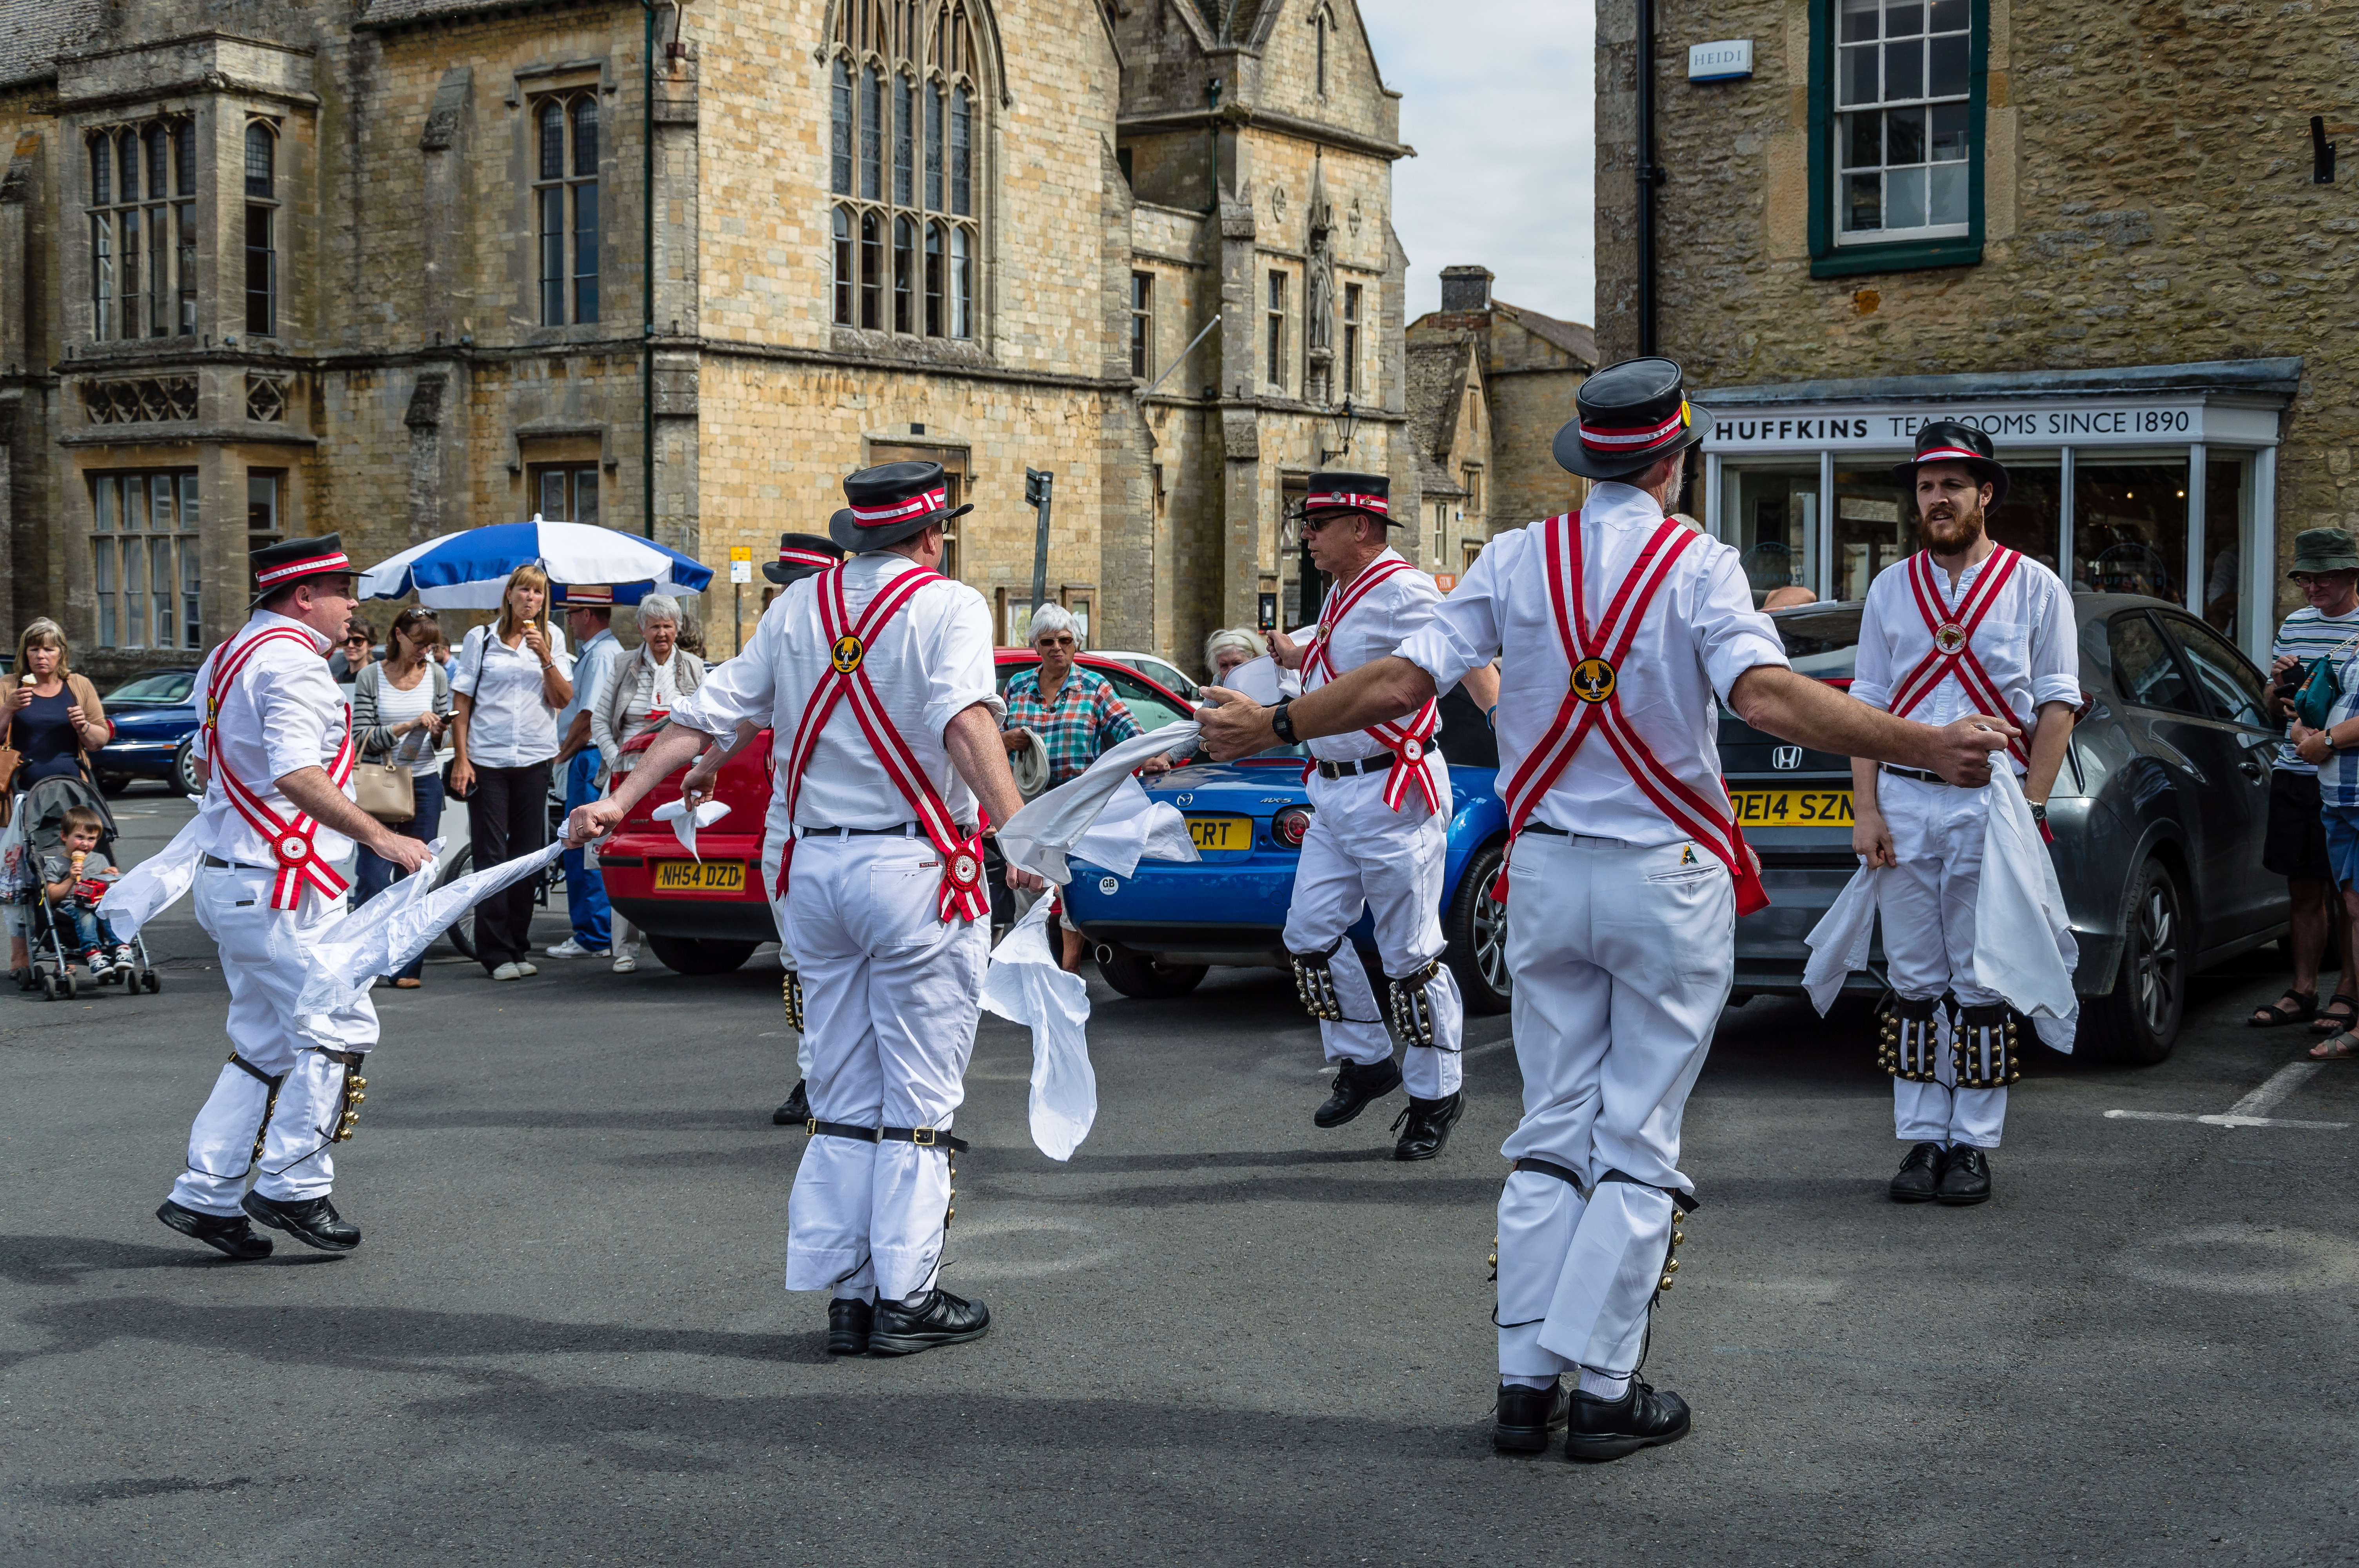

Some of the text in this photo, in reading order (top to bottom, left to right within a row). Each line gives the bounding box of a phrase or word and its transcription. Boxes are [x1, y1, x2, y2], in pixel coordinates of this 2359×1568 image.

[1694, 50, 1741, 66] HEIDI
[1716, 419, 1868, 440] HUFFKINS
[2048, 412, 2126, 434] SINCE
[2136, 411, 2189, 432] 1890
[1439, 577, 1452, 589] STOW
[1798, 794, 1855, 820] SZN
[1189, 822, 1231, 846] CRT
[662, 865, 738, 887] NH54 DZD
[1102, 878, 1115, 888] GB
